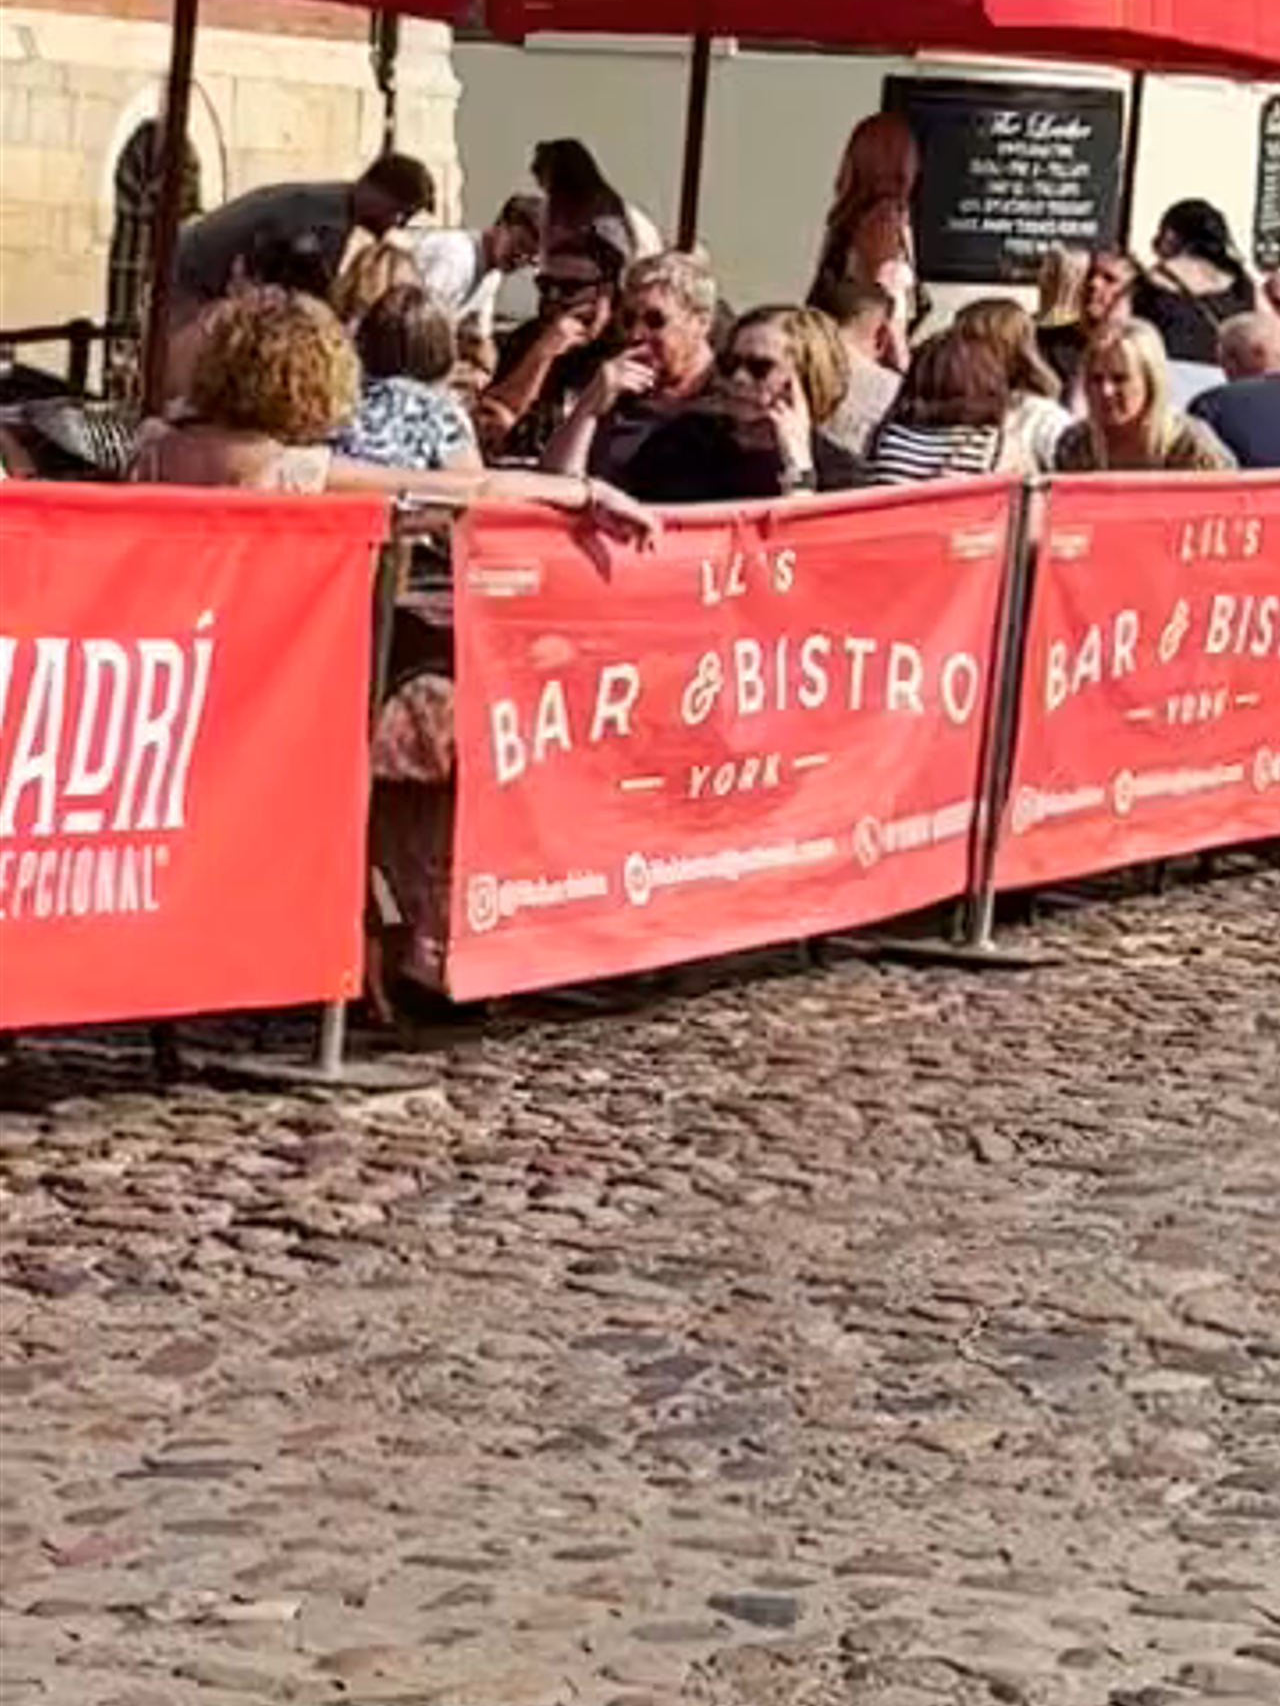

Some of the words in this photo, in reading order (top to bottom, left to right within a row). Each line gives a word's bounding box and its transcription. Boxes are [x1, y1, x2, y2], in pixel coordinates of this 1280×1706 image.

[490, 661, 641, 784] BAR
[681, 650, 724, 726] &
[732, 633, 980, 726] BISTRO
[1044, 608, 1138, 714] BAR
[689, 751, 781, 800] YORK
